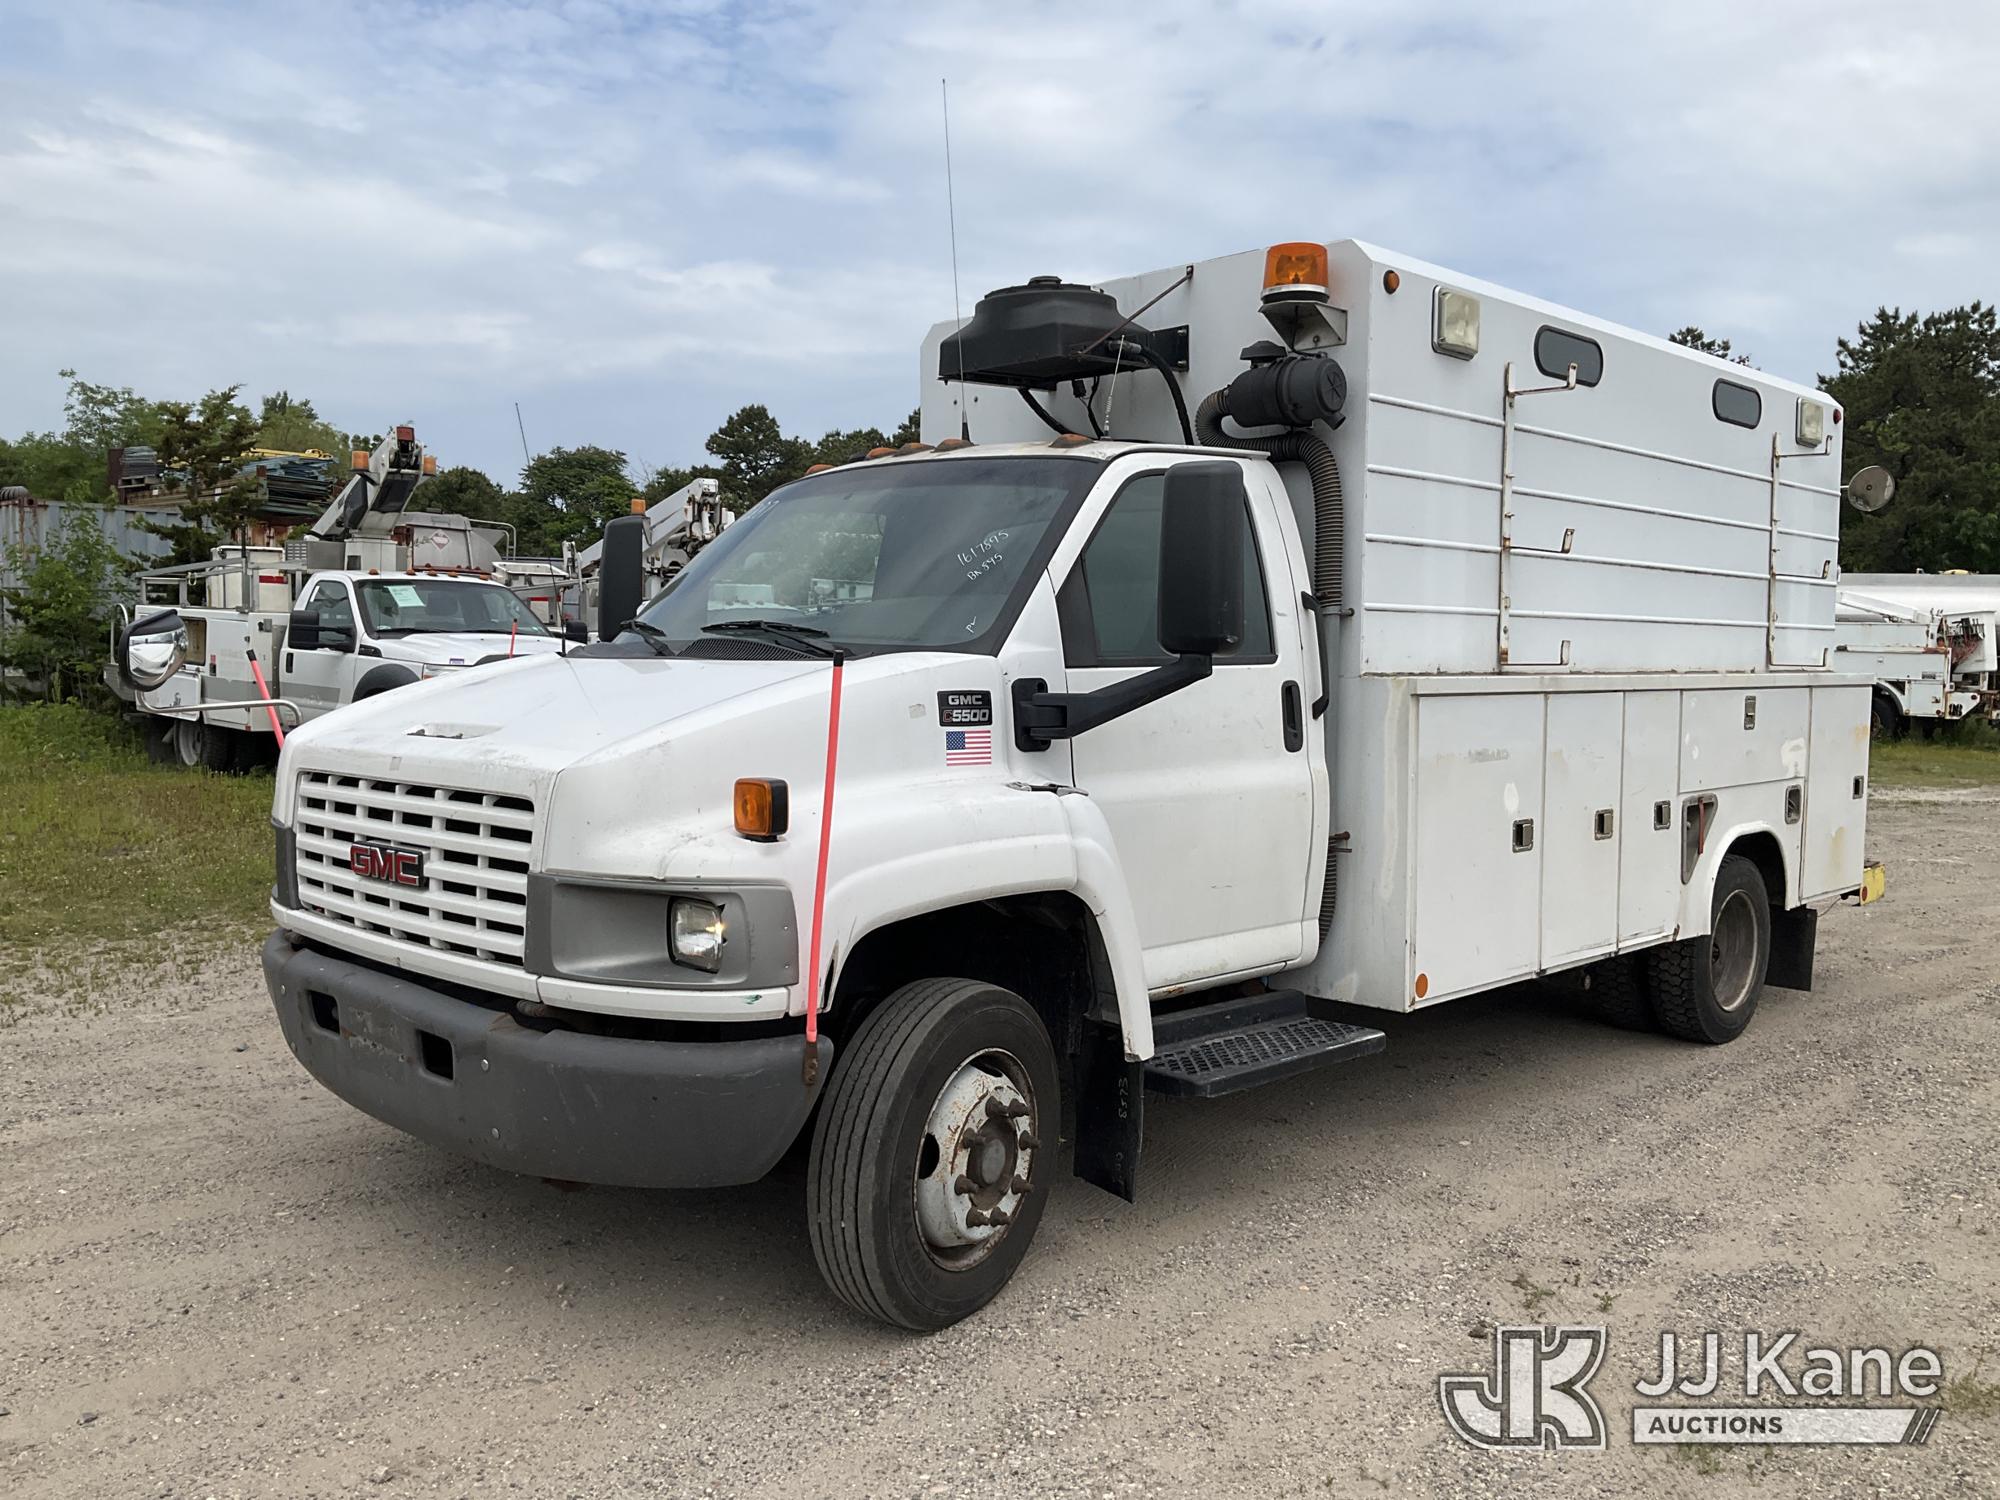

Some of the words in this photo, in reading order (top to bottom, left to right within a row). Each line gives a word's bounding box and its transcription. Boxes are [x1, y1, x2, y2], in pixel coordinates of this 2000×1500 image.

[948, 695, 982, 705] GMC
[943, 709, 989, 722] C5500
[350, 843, 419, 886] GMC
